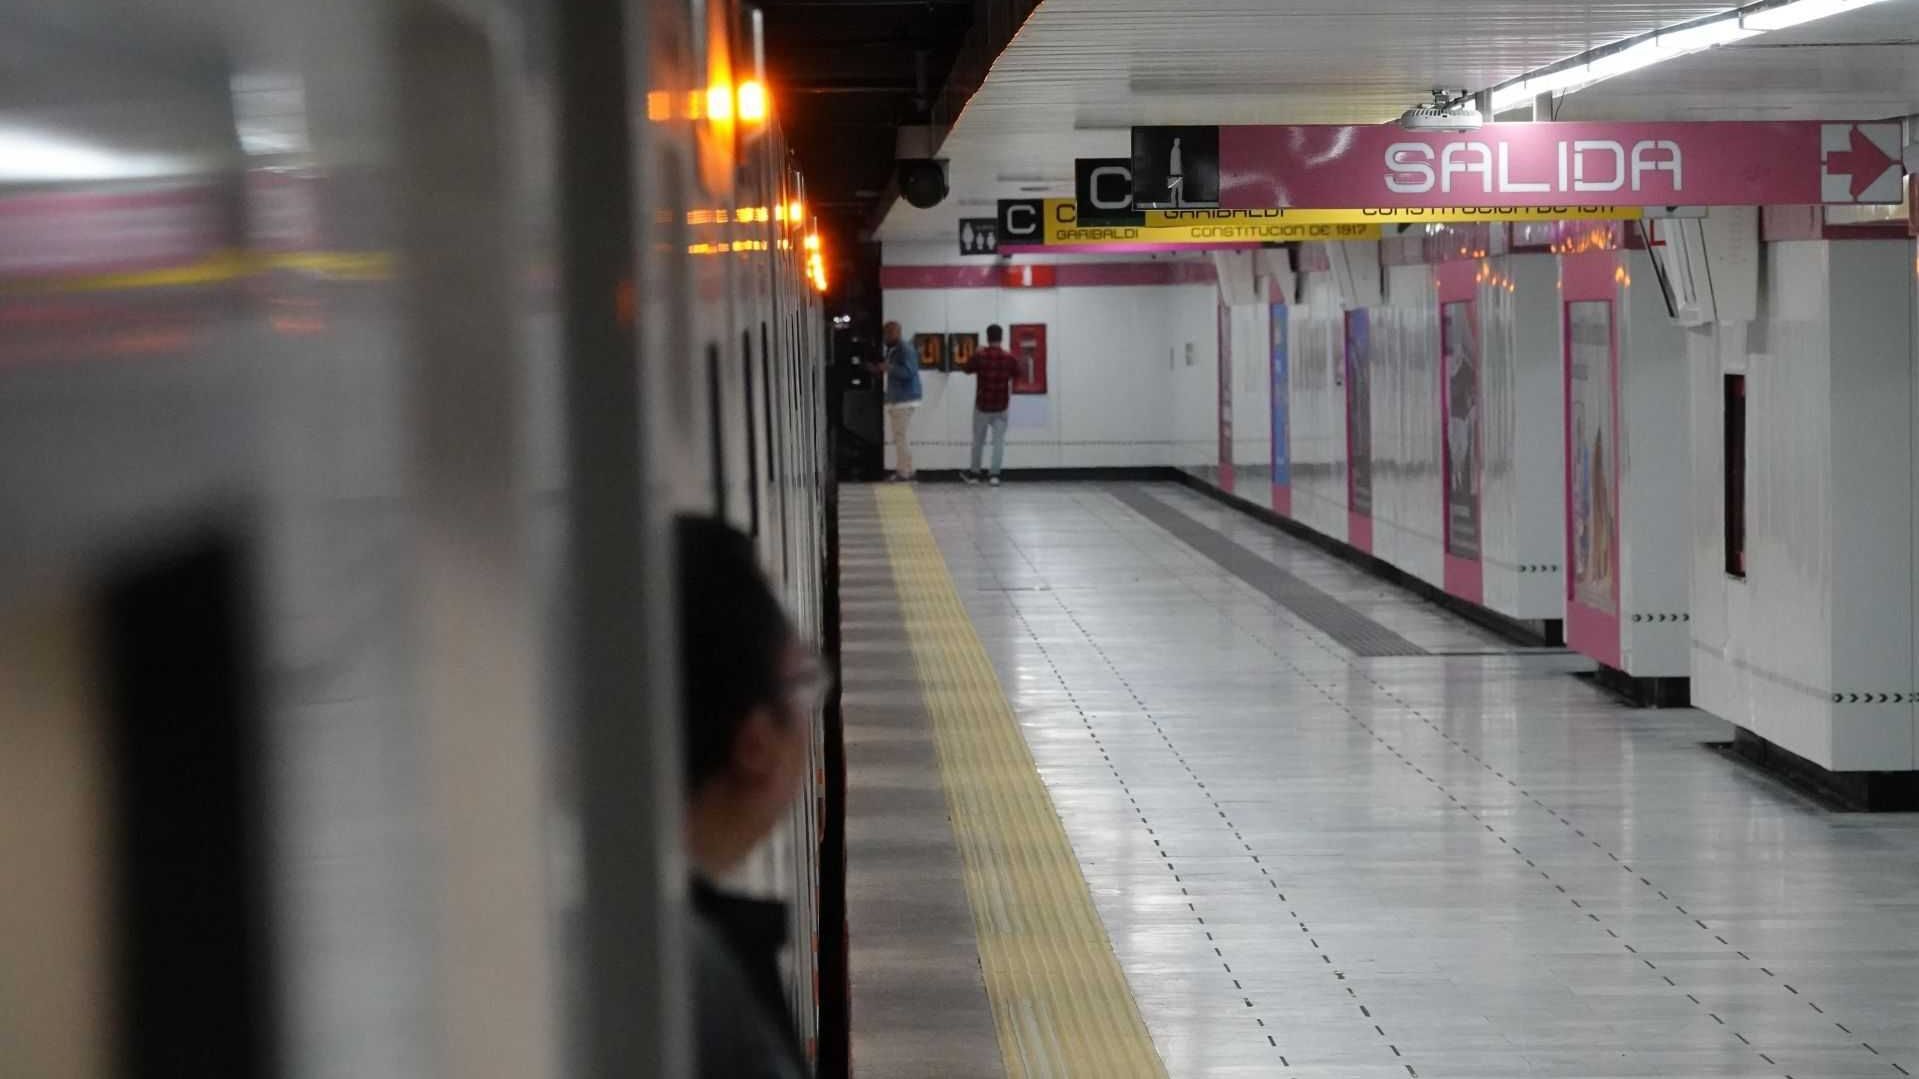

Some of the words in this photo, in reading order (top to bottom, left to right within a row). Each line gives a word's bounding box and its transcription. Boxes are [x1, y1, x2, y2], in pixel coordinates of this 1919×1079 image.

[1384, 139, 1683, 193] SALIDA
[1090, 166, 1132, 209] C
[1007, 205, 1036, 234] C
[1056, 228, 1139, 240] GARIBALDI
[1310, 223, 1329, 236] DE
[1336, 223, 1367, 235] 1917
